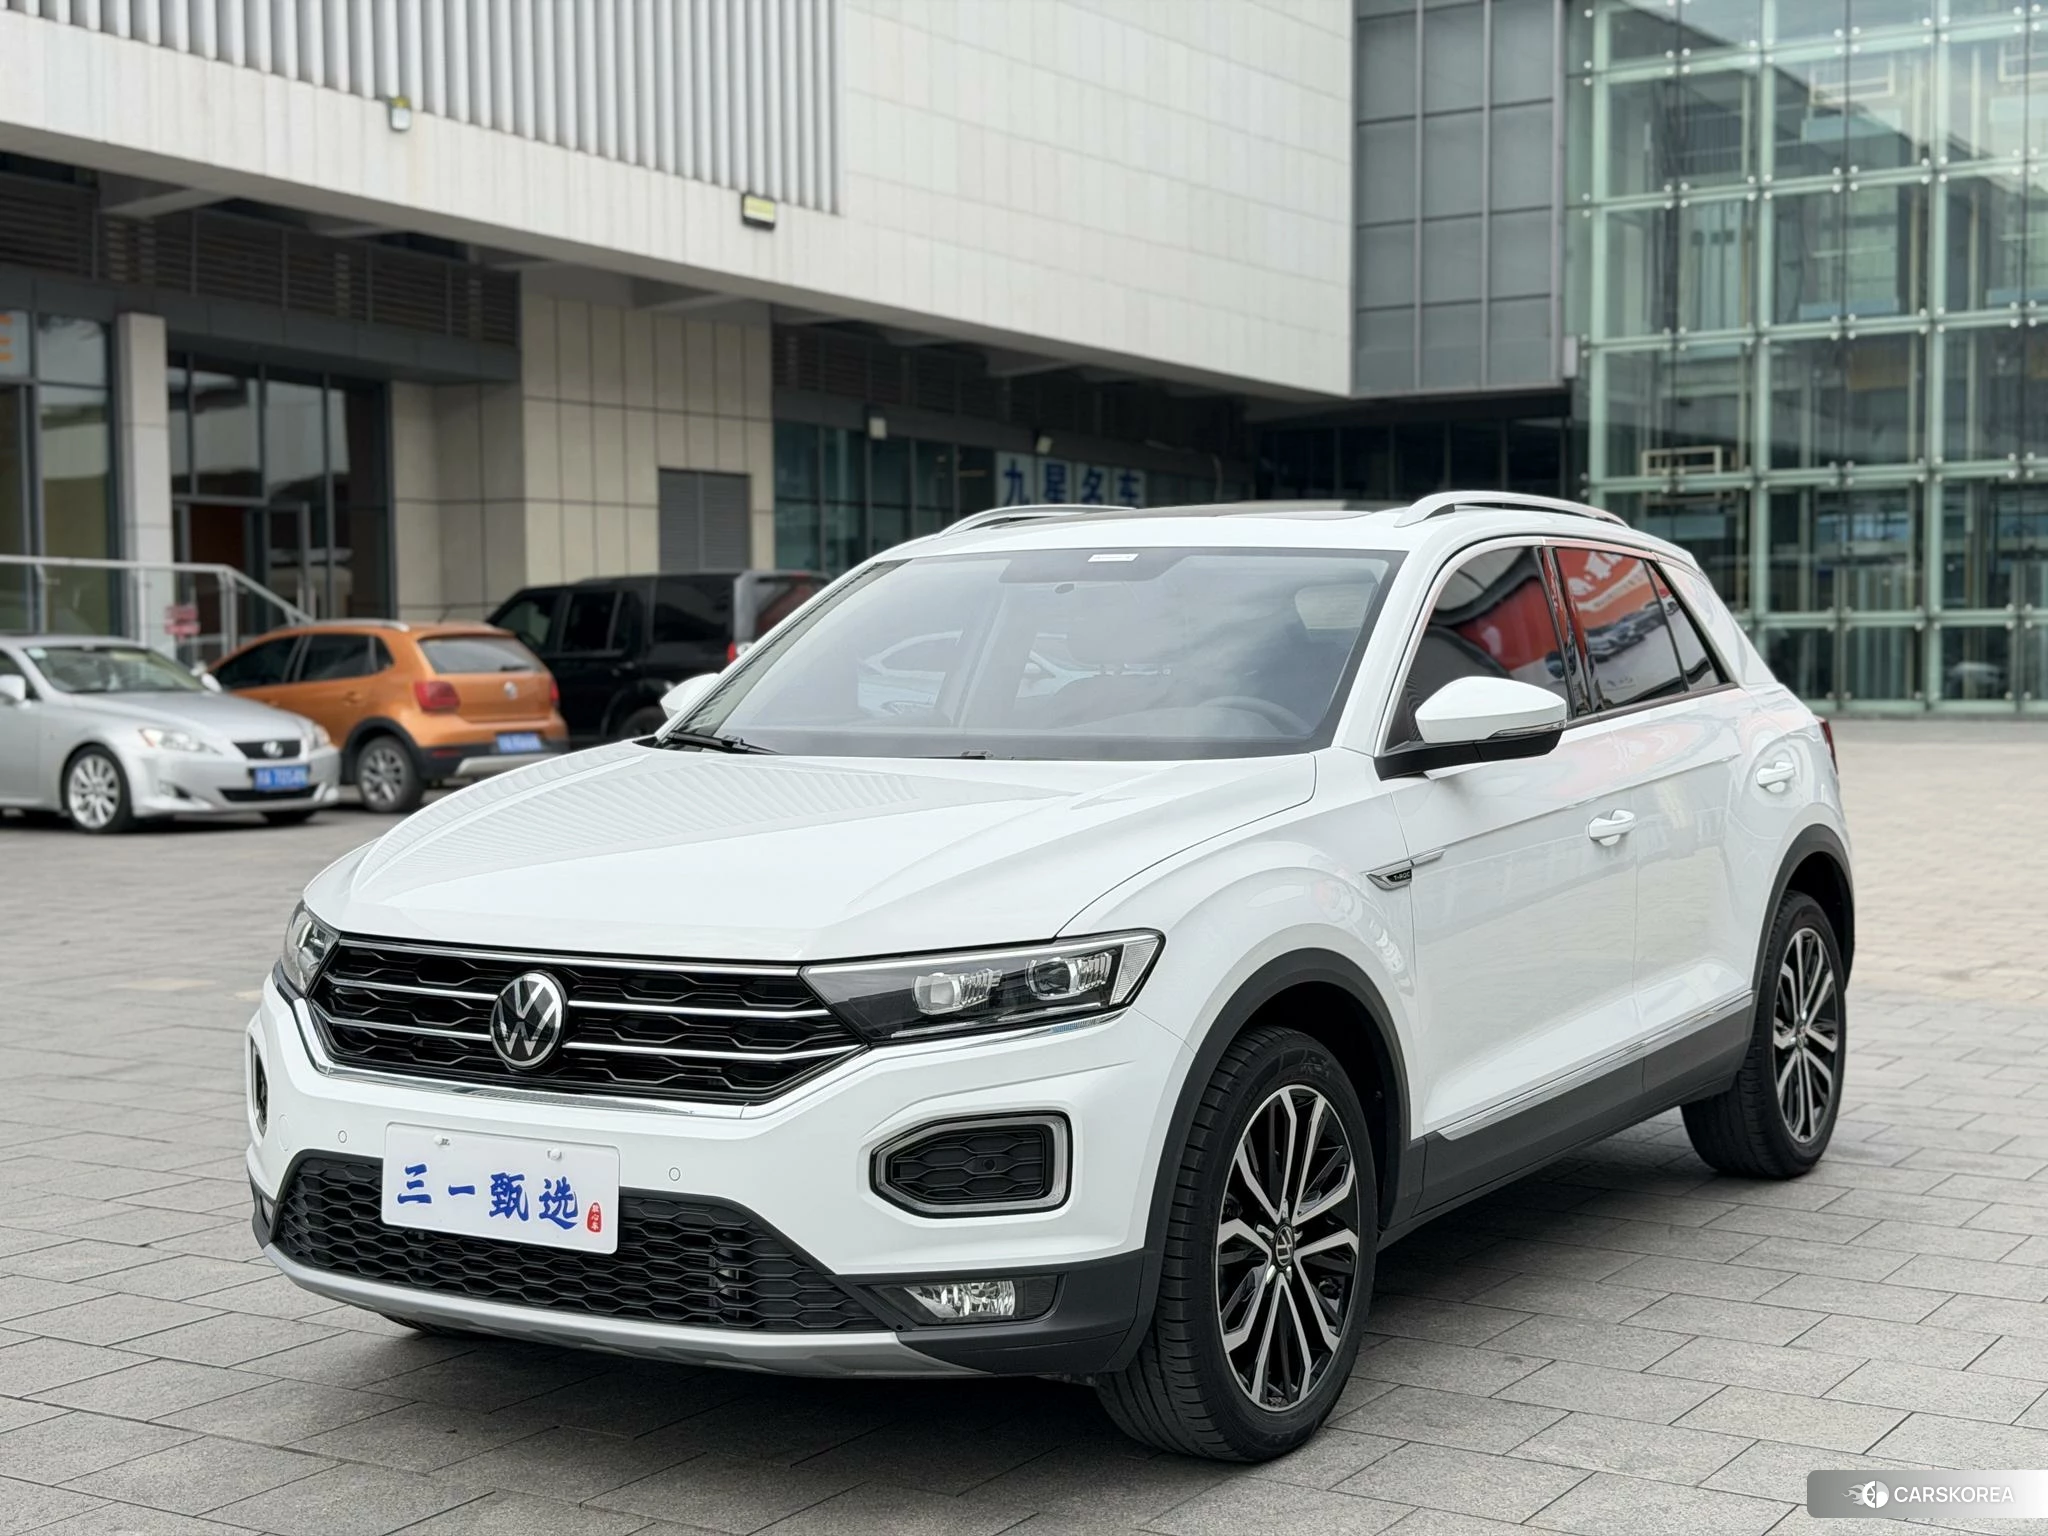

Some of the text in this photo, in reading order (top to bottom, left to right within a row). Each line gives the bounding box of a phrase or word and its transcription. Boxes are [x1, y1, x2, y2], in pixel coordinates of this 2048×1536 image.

[1003, 456, 1141, 508] 九星名车
[397, 1163, 579, 1230] 三一甄选
